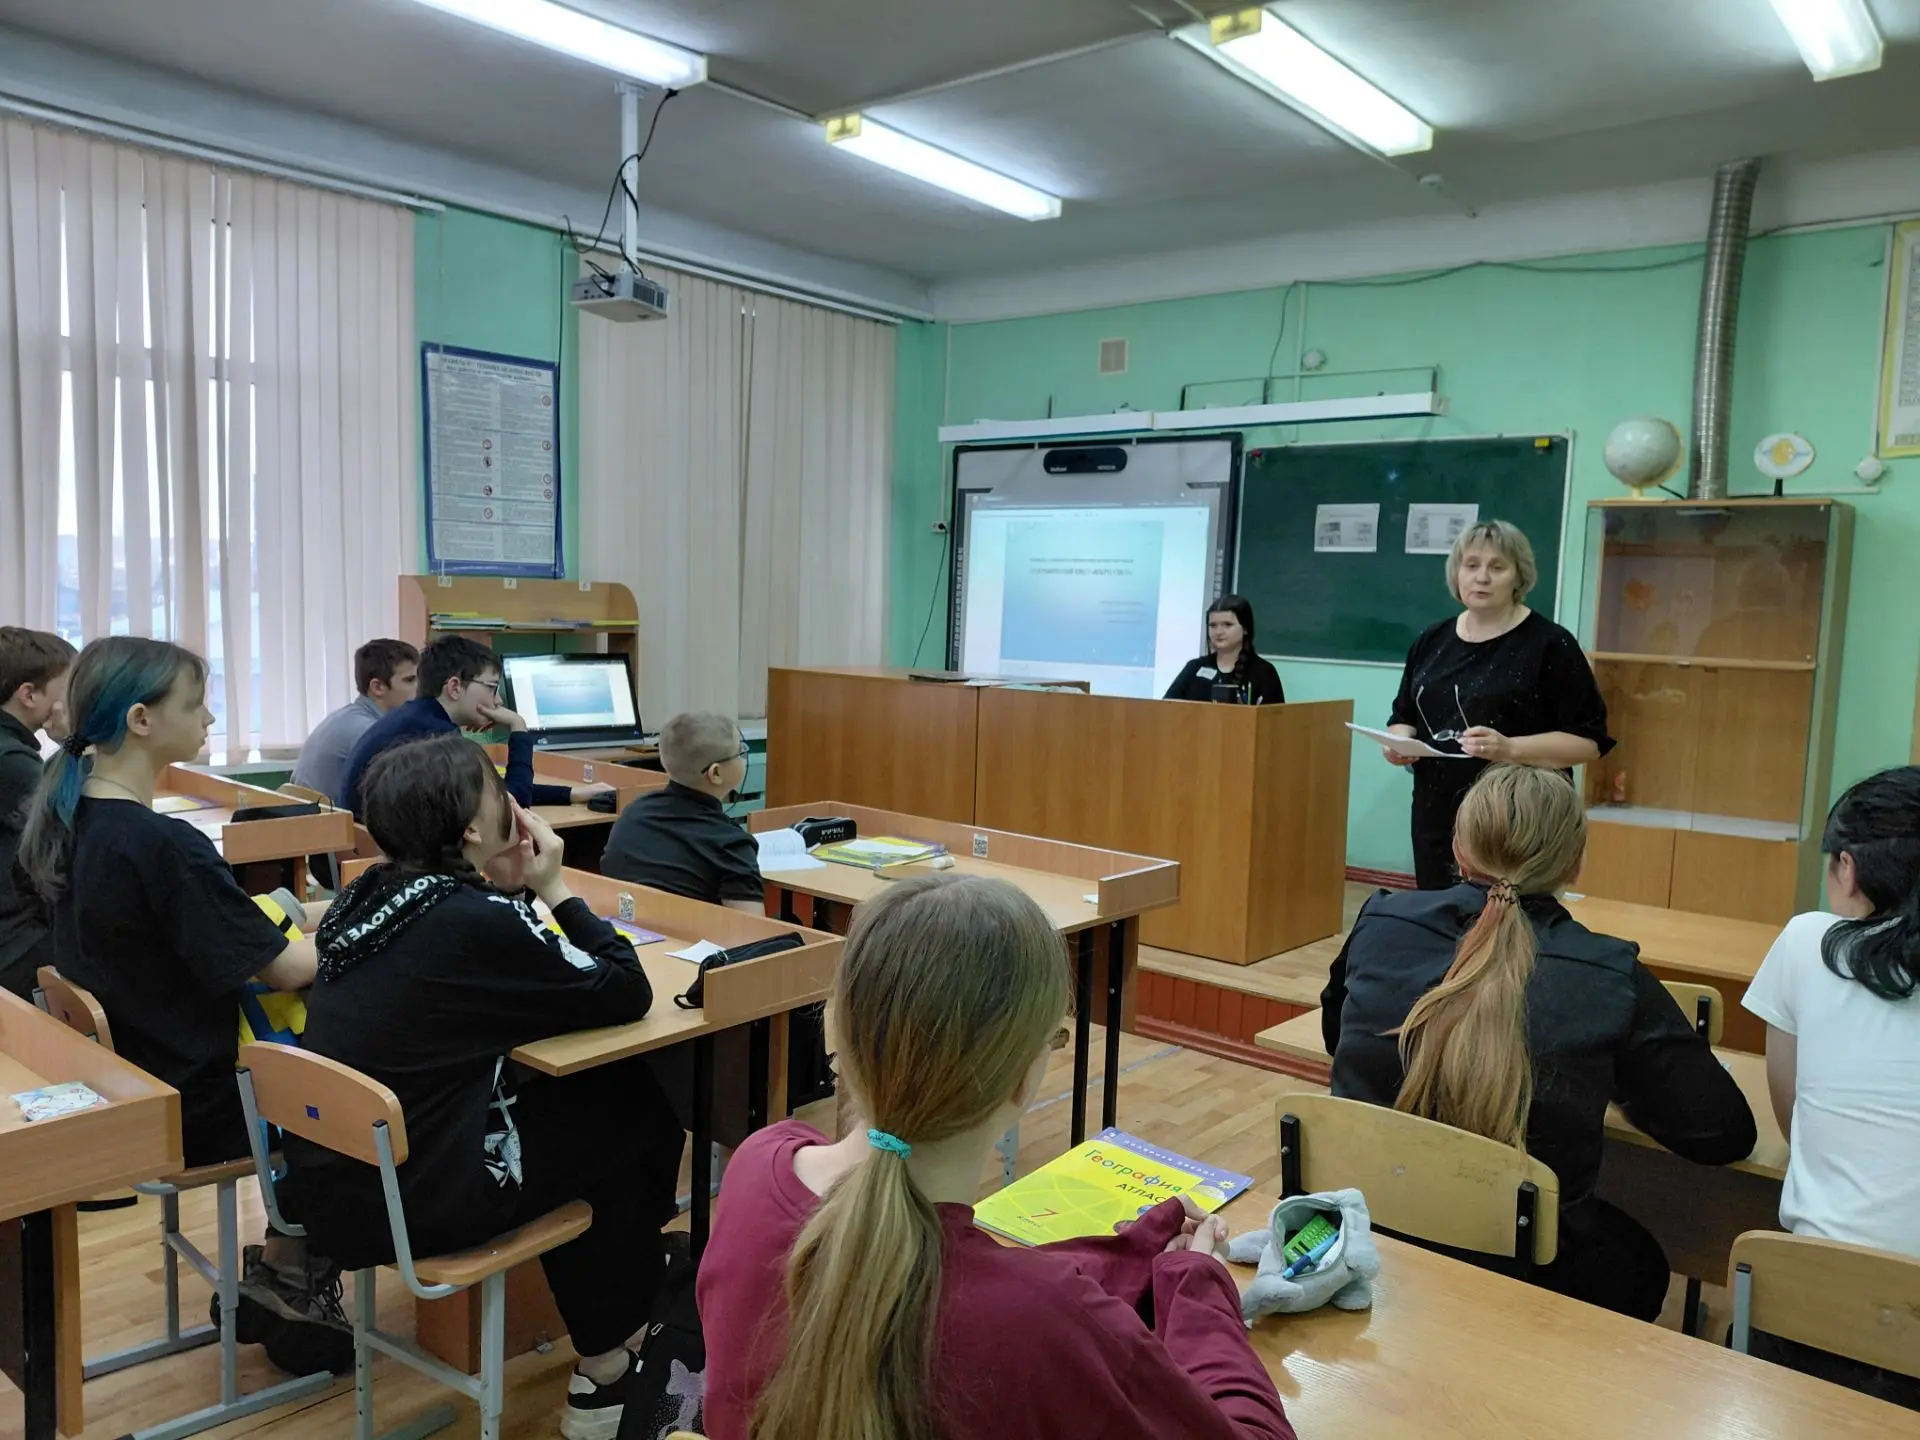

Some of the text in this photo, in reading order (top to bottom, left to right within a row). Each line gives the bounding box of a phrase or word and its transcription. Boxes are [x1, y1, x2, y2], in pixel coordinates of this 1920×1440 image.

[392, 875, 438, 908] LOVE
[347, 904, 394, 941] LOVE
[1085, 1149, 1182, 1192] География
[1115, 1183, 1167, 1203] АТЛАС
